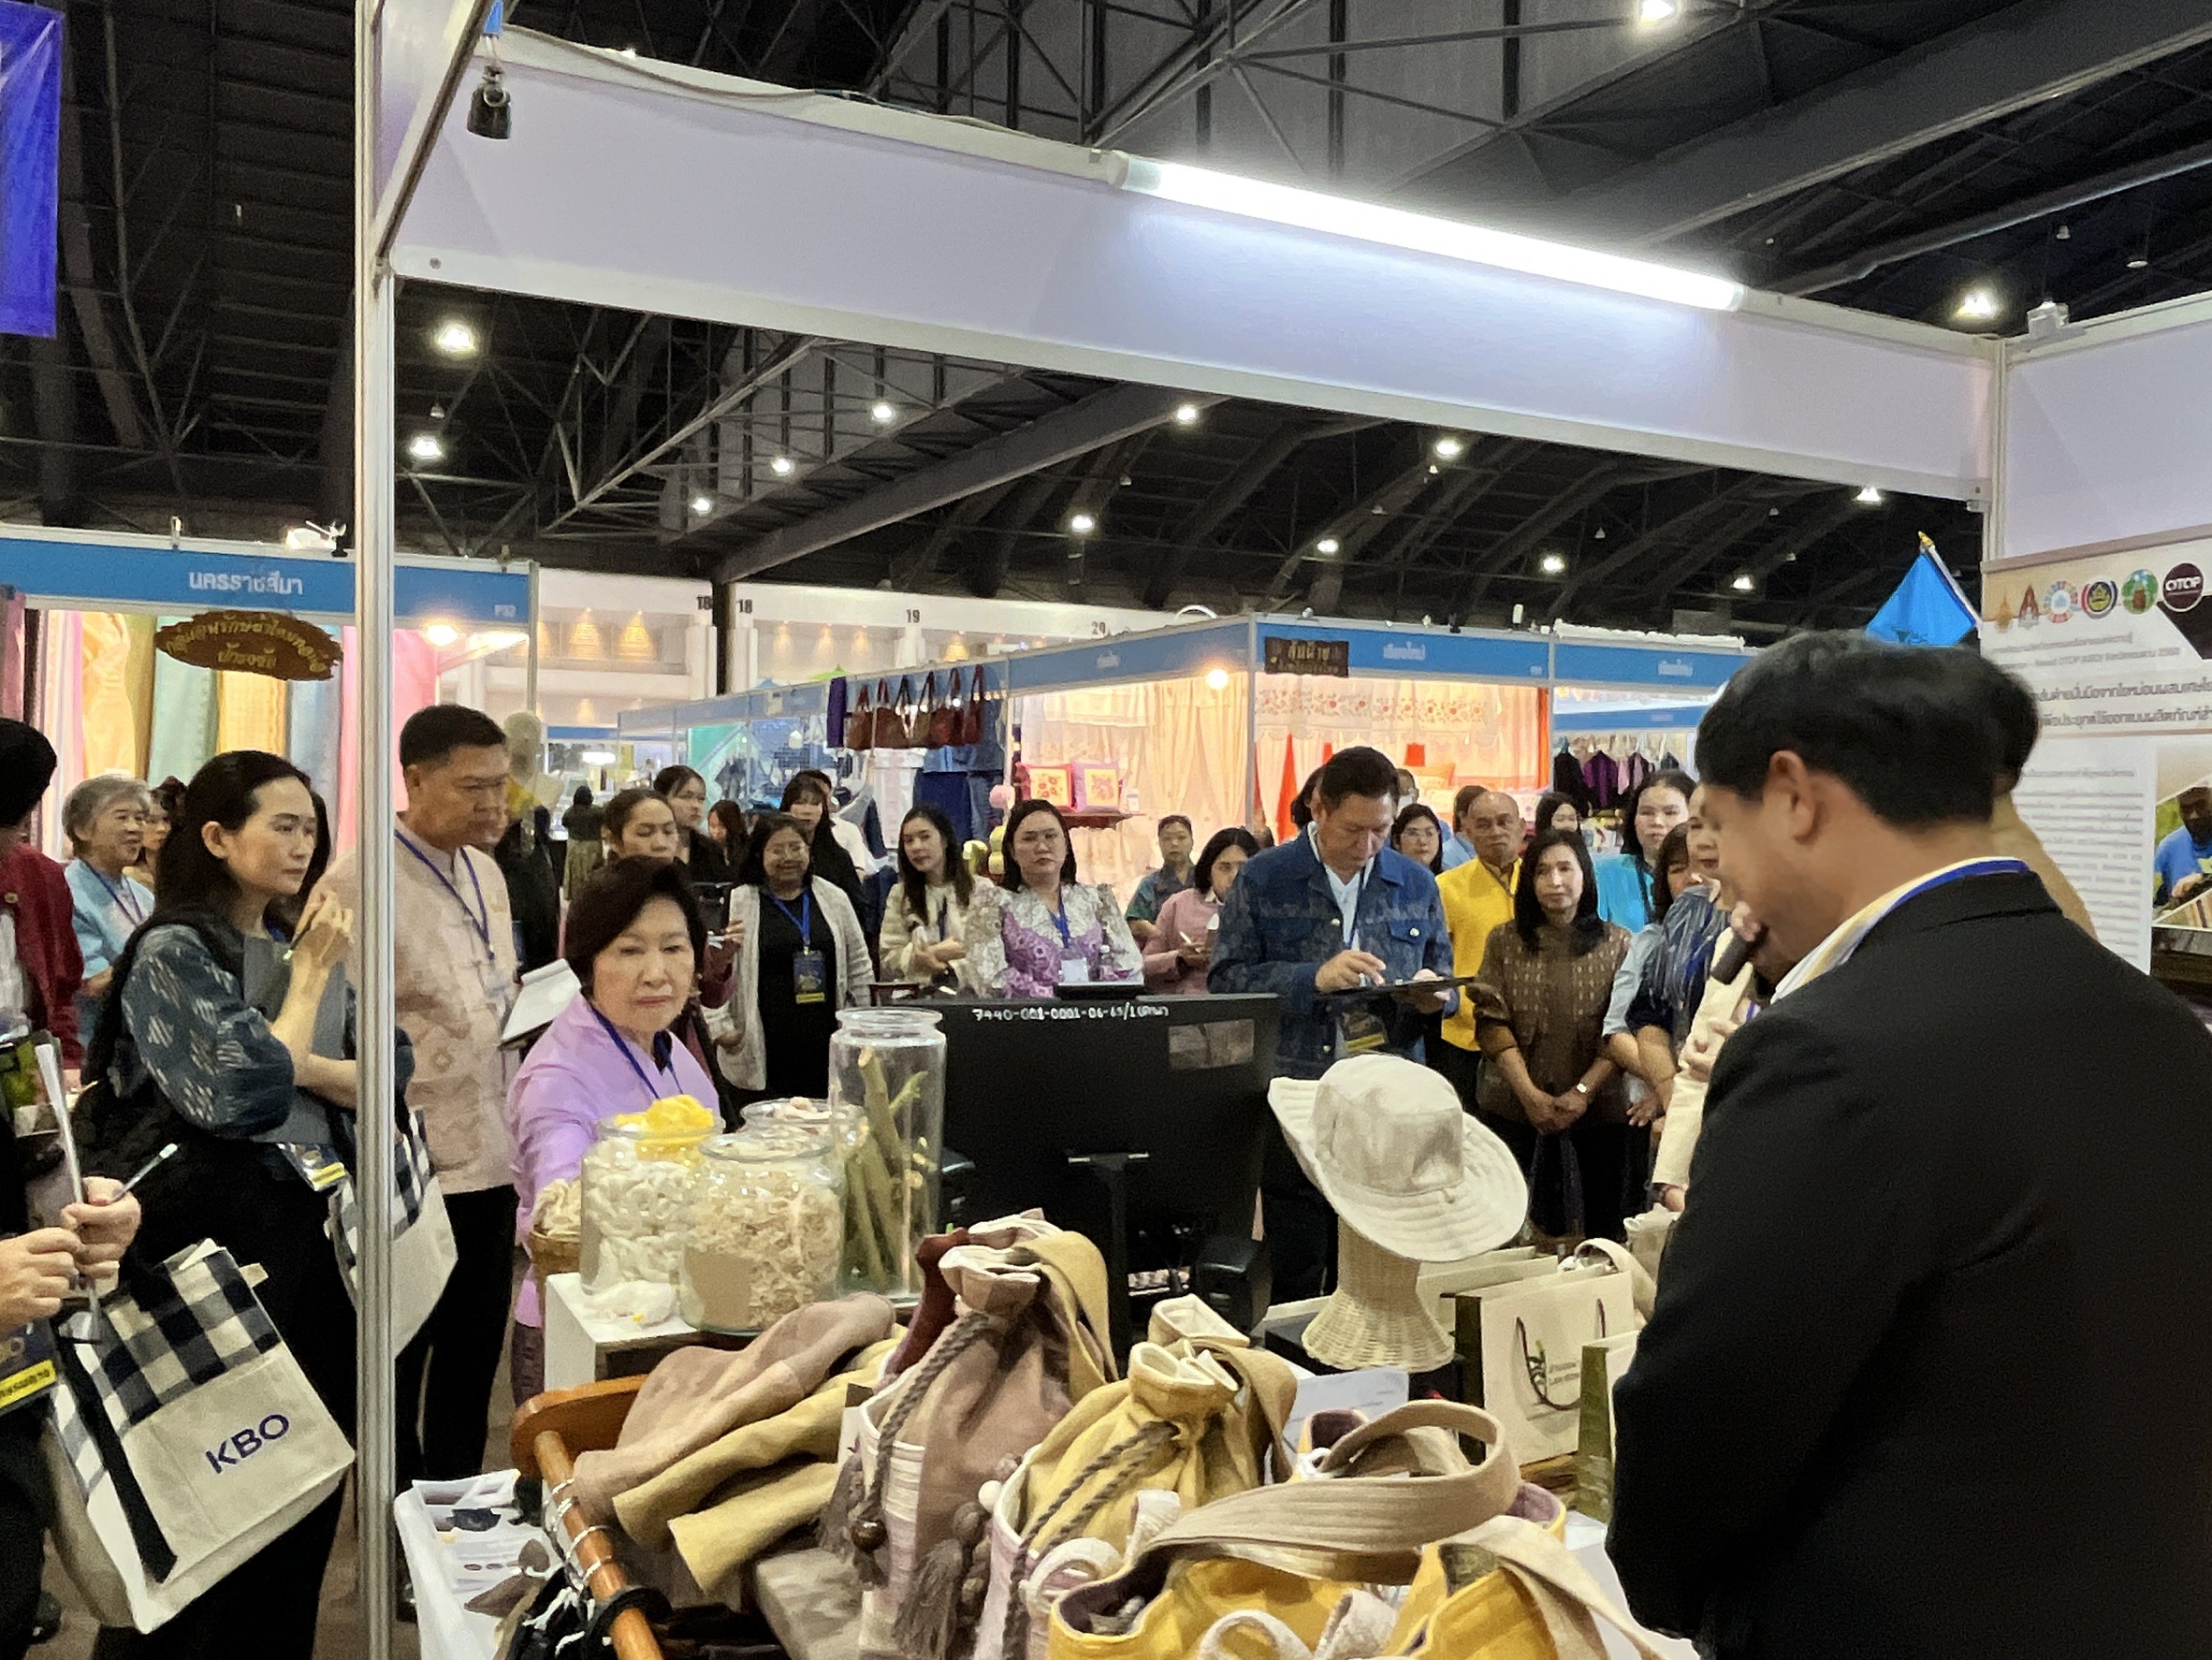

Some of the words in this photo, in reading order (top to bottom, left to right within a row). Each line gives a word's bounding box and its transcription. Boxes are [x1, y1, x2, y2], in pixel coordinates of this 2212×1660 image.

[188, 570, 304, 595] นครราชสีมา
[2165, 576, 2201, 590] OTOP
[909, 609, 921, 623] 19
[206, 1413, 289, 1475] KBO
